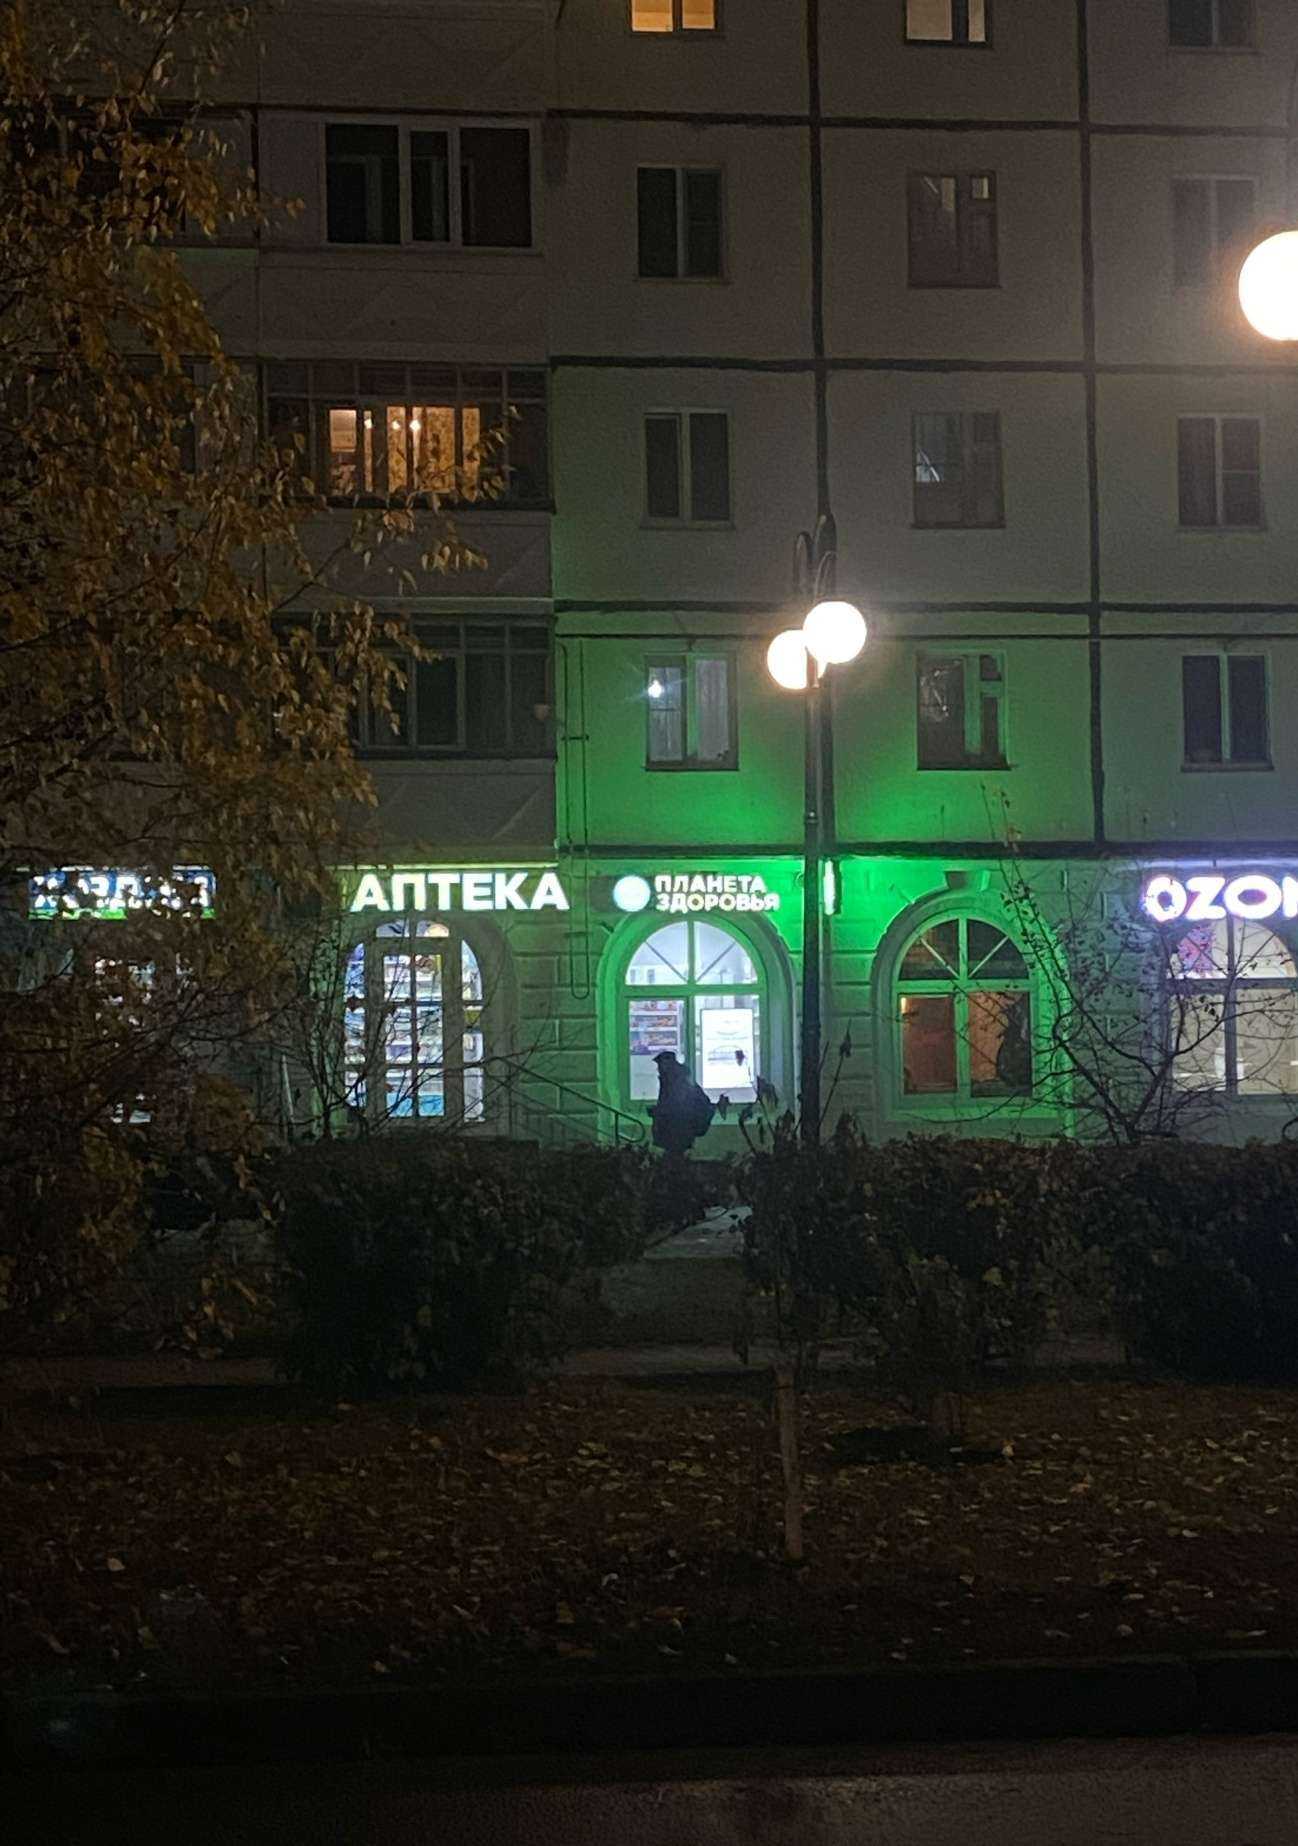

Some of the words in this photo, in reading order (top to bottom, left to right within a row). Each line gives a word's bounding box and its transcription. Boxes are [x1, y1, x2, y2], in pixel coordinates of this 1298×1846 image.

[351, 872, 570, 912] АПТЕКА
[654, 875, 767, 893] ПЛАНЕТА
[655, 893, 780, 913] ЗДОРОВЬЯ
